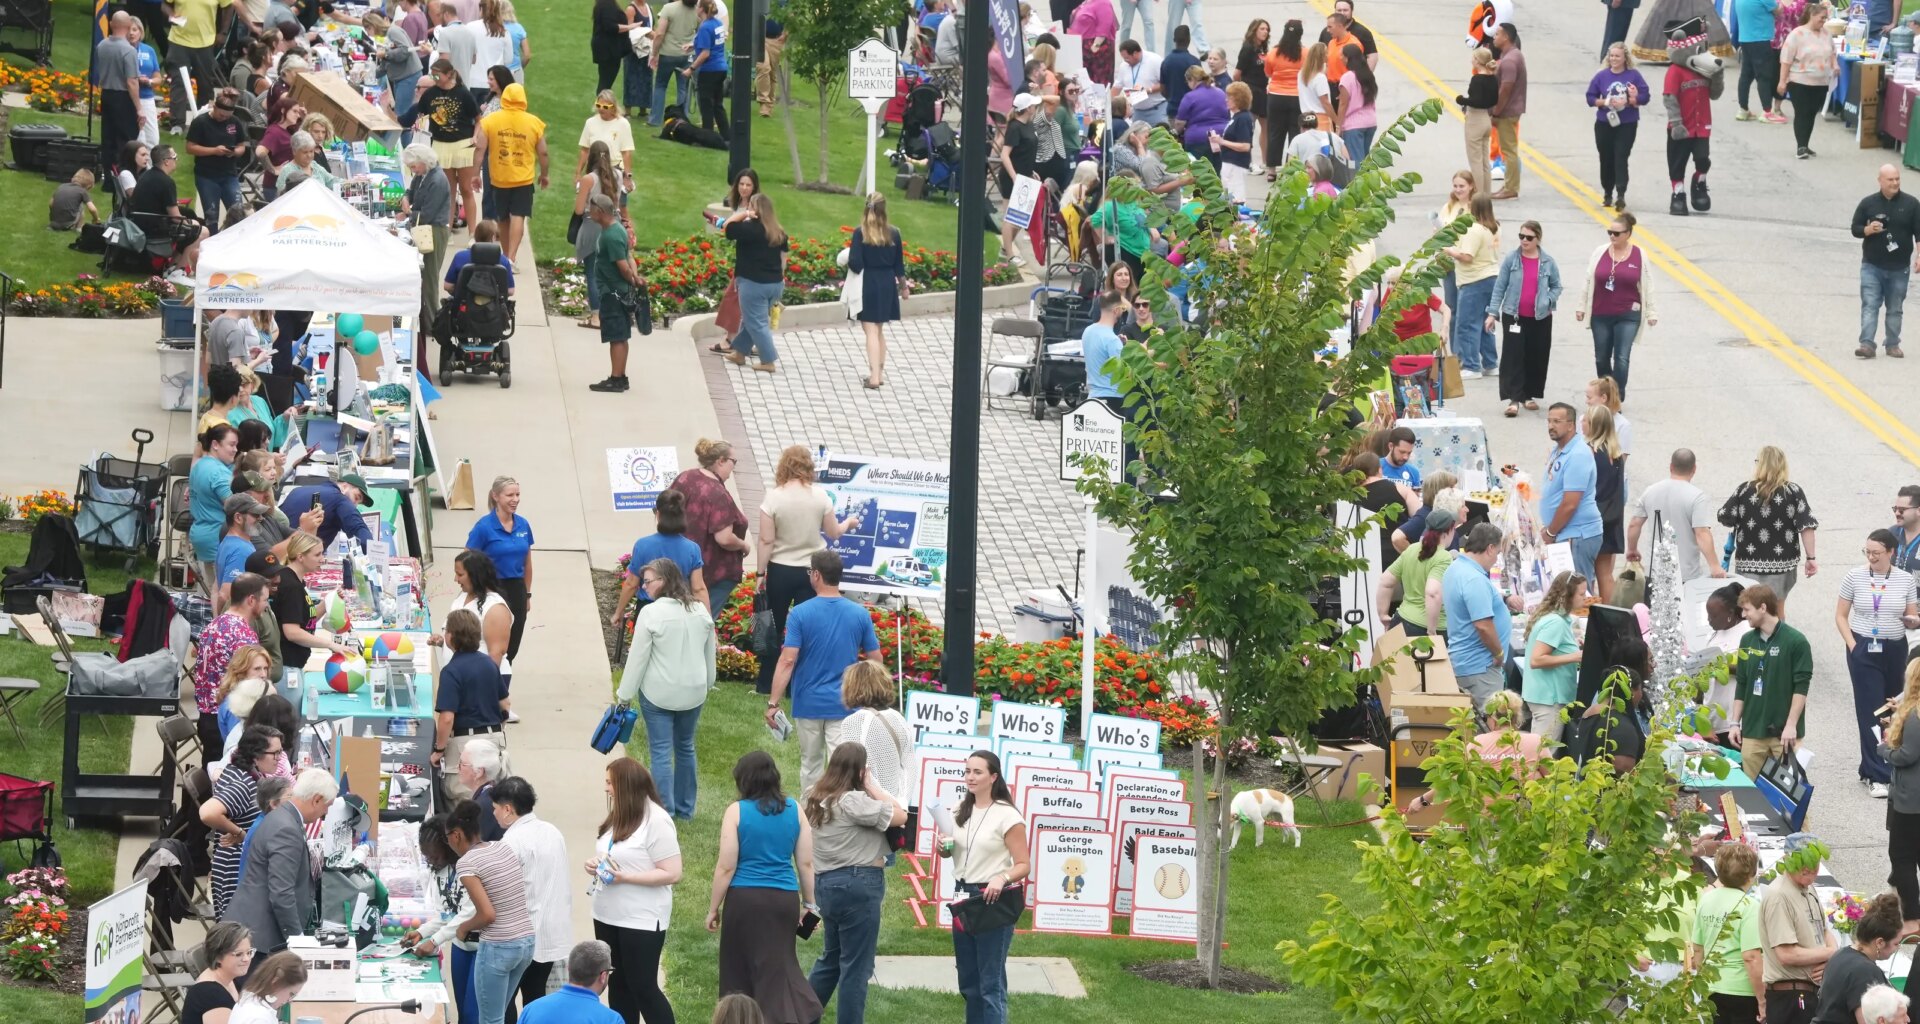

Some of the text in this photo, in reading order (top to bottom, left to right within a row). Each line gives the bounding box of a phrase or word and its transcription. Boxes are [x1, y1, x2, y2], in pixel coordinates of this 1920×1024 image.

[853, 67, 893, 77] PRIVATE
[852, 80, 893, 90] PARKING
[272, 238, 347, 248] PARTNERSHIP
[1066, 438, 1118, 454] PRIVATE
[624, 448, 658, 474] ERIE GIVES
[828, 467, 852, 477] MHEDS
[867, 468, 950, 483] Where Should We Go Next
[897, 521, 910, 529] County
[829, 546, 860, 556] Crawford County
[928, 556, 939, 564] You!
[916, 702, 969, 725] Who's
[1002, 712, 1054, 736] Who's
[1097, 725, 1150, 748] Who's
[934, 767, 966, 777] Liberty
[1032, 774, 1074, 786] American
[1116, 783, 1180, 798] Declaration of
[1042, 797, 1083, 809] Buffalo
[1130, 805, 1179, 817] Betsy Ross
[1037, 823, 1080, 832] American
[1134, 828, 1185, 838] Bald Eagle
[1058, 834, 1093, 846] George
[1047, 845, 1103, 856] Washington
[1152, 844, 1197, 857] Baseball
[116, 912, 139, 933] Nonprofit
[116, 925, 144, 945] Partnership
